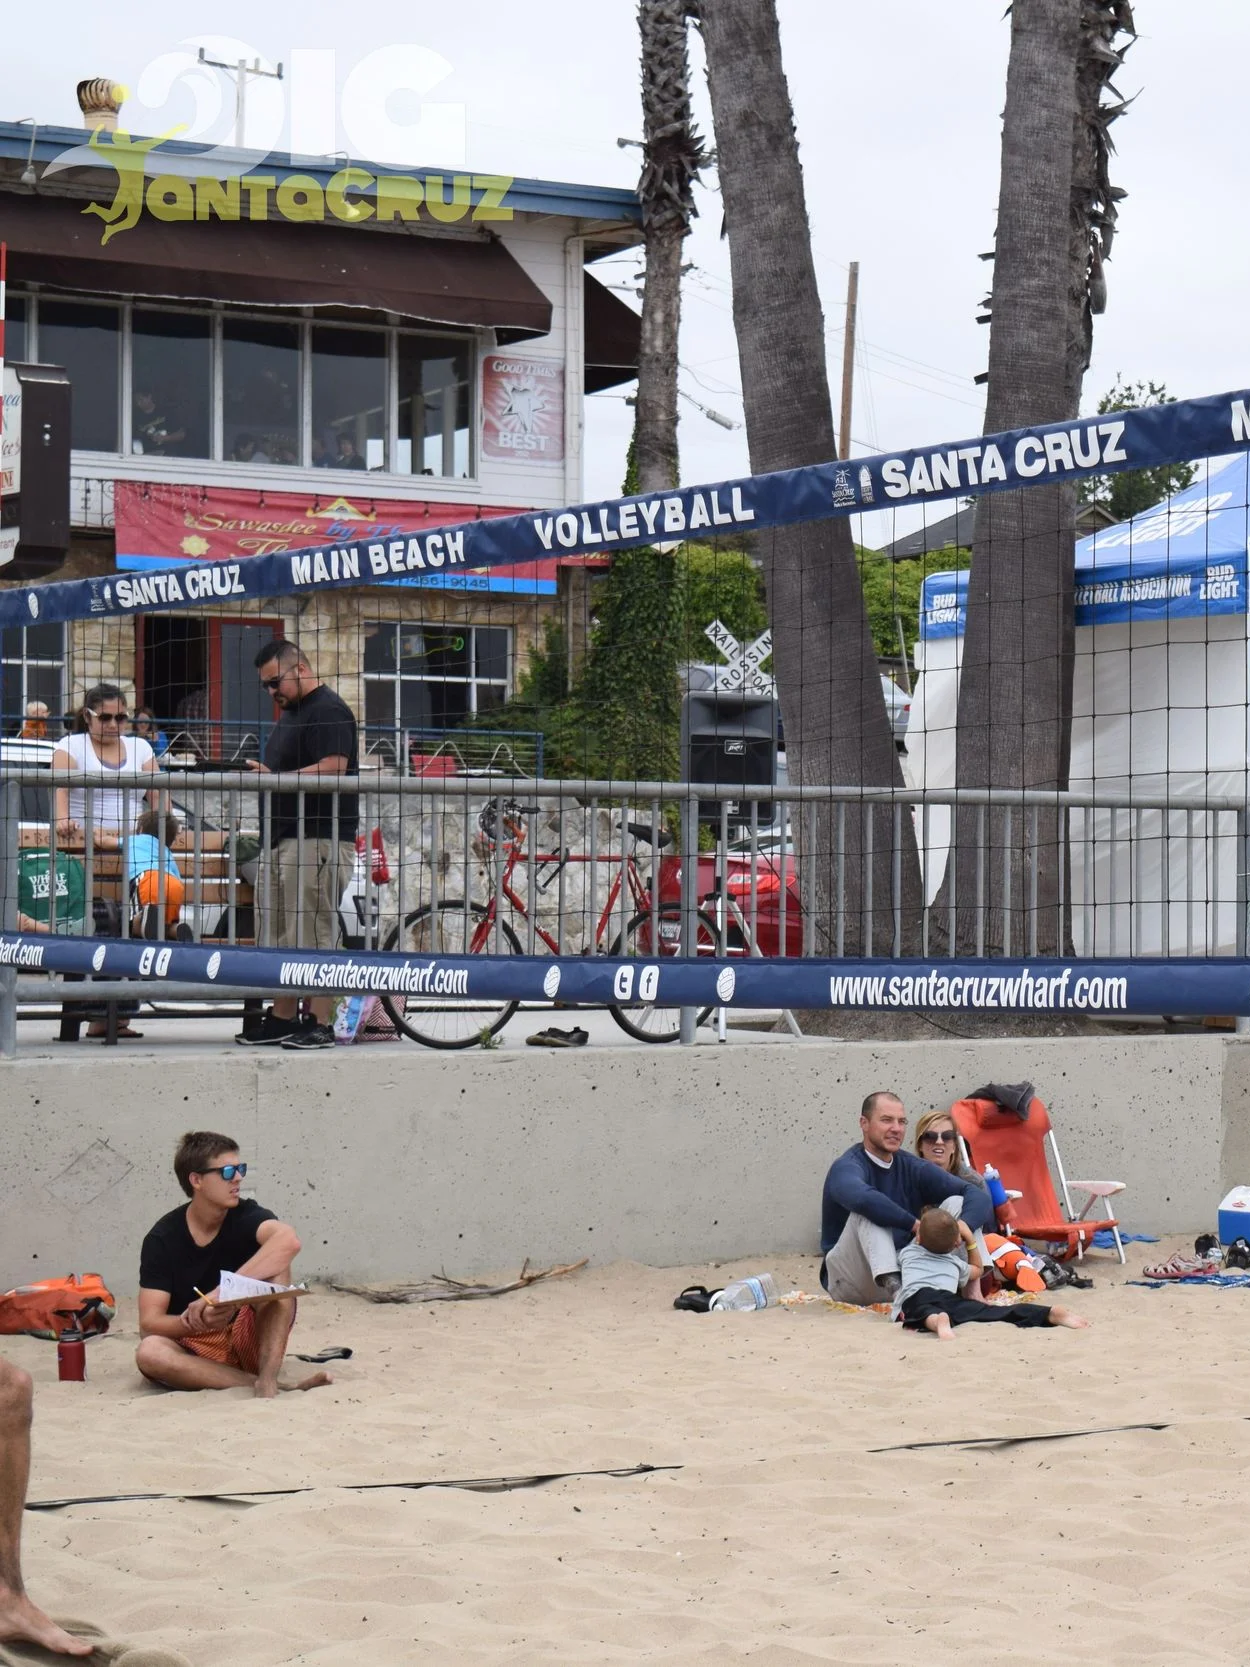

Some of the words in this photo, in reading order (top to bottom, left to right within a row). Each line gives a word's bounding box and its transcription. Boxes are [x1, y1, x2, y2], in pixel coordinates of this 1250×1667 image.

[498, 432, 549, 451] BEST
[881, 444, 1006, 498] SANTA
[1014, 421, 1127, 478] CRUZ
[196, 512, 317, 535] Sawasdee
[534, 487, 755, 549] VOLLEYBALL
[115, 577, 184, 608] SANTA
[185, 564, 245, 598] CRUZ
[291, 548, 361, 585] MAIN
[368, 531, 465, 575] BEACH
[1207, 564, 1235, 582] BUD
[933, 593, 957, 609] BUD
[1200, 581, 1239, 599] LIGHT
[708, 624, 738, 660] RAIL
[719, 636, 773, 690] ROSSIN
[280, 960, 468, 994] www.santacruzwharf.com
[830, 968, 1127, 1009] www.santacruzwharf.com
